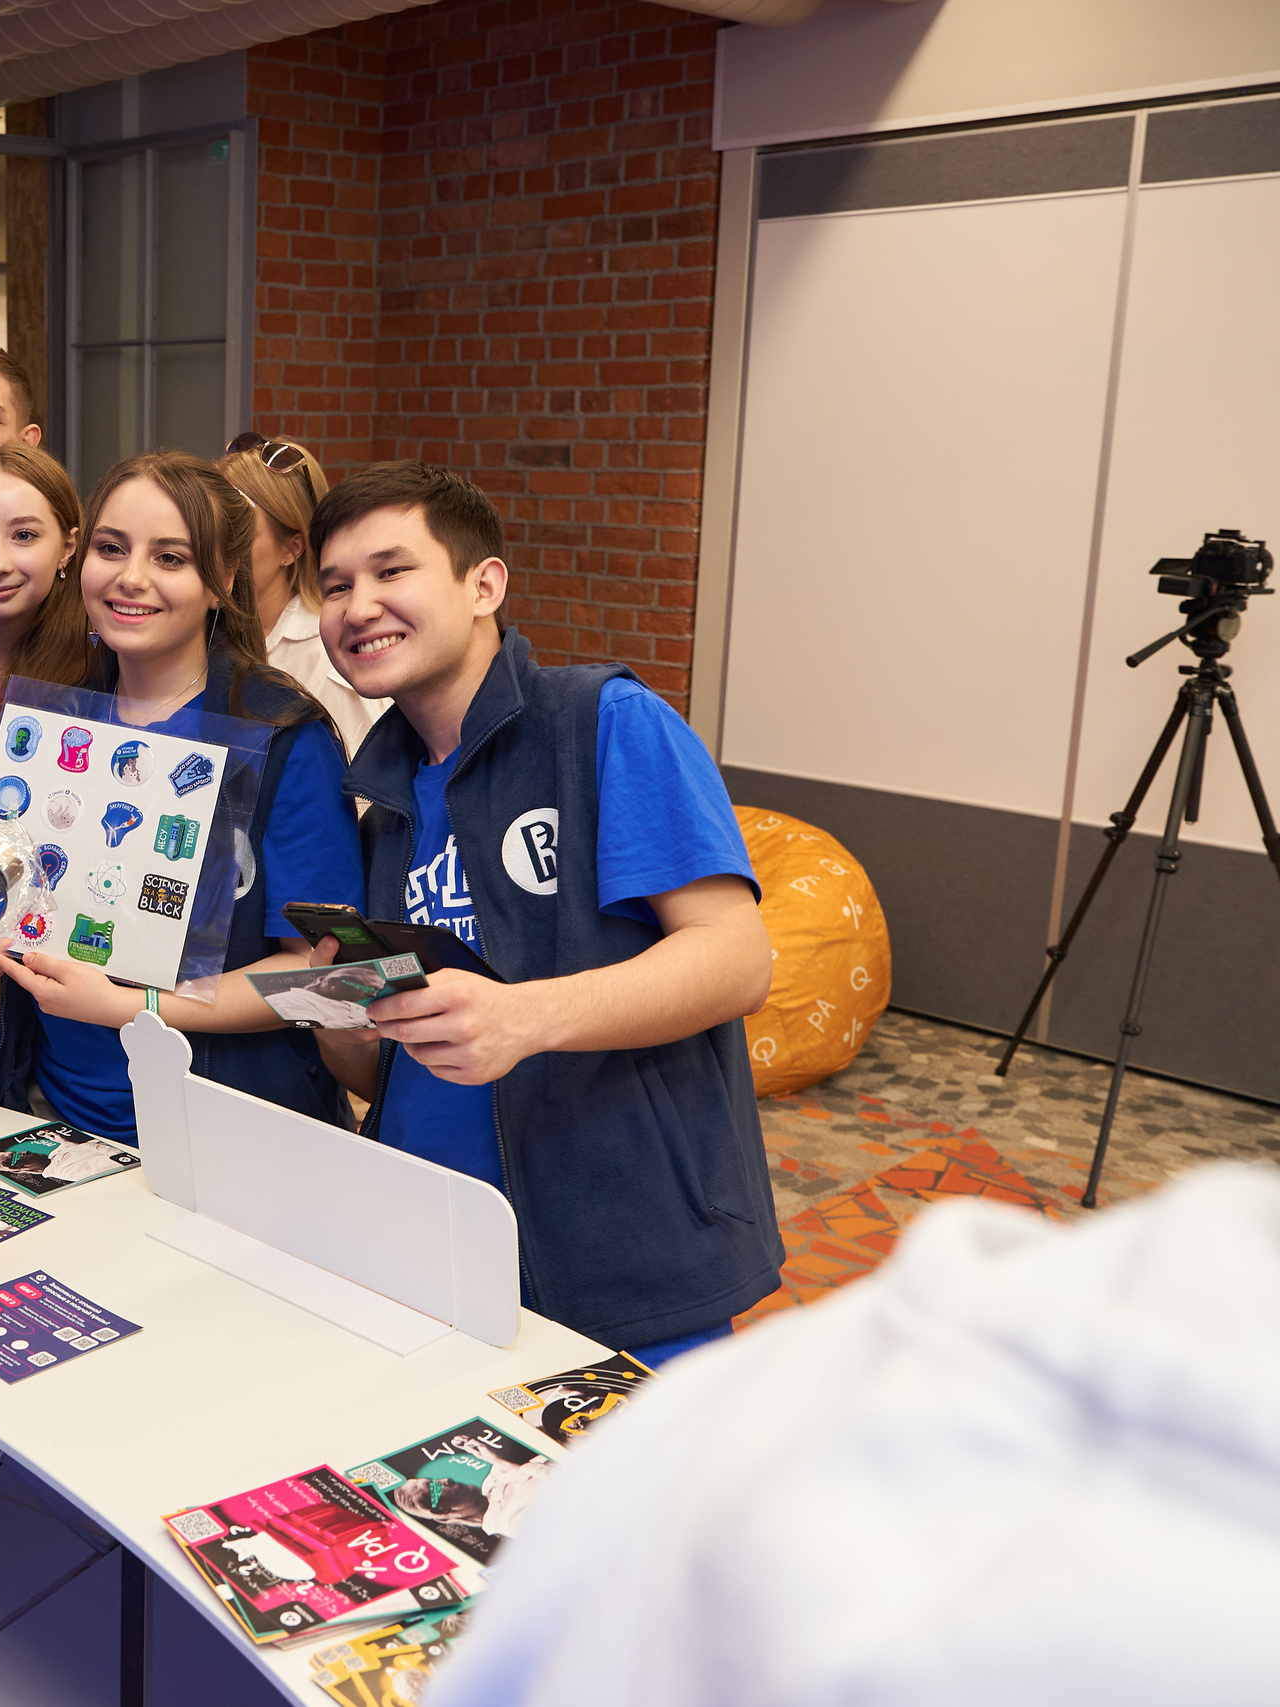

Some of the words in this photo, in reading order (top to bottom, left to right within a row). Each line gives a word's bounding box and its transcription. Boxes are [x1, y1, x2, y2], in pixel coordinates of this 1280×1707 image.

[157, 828, 168, 850] НЕСУ
[184, 822, 197, 849] ТЕПЛО
[145, 875, 187, 895] SCIENCE
[139, 895, 182, 918] BLACK
[170, 895, 184, 904] NEW
[10, 1203, 47, 1220] НАУКИ
[347, 1529, 400, 1558] pA
[393, 1545, 430, 1575] Q
